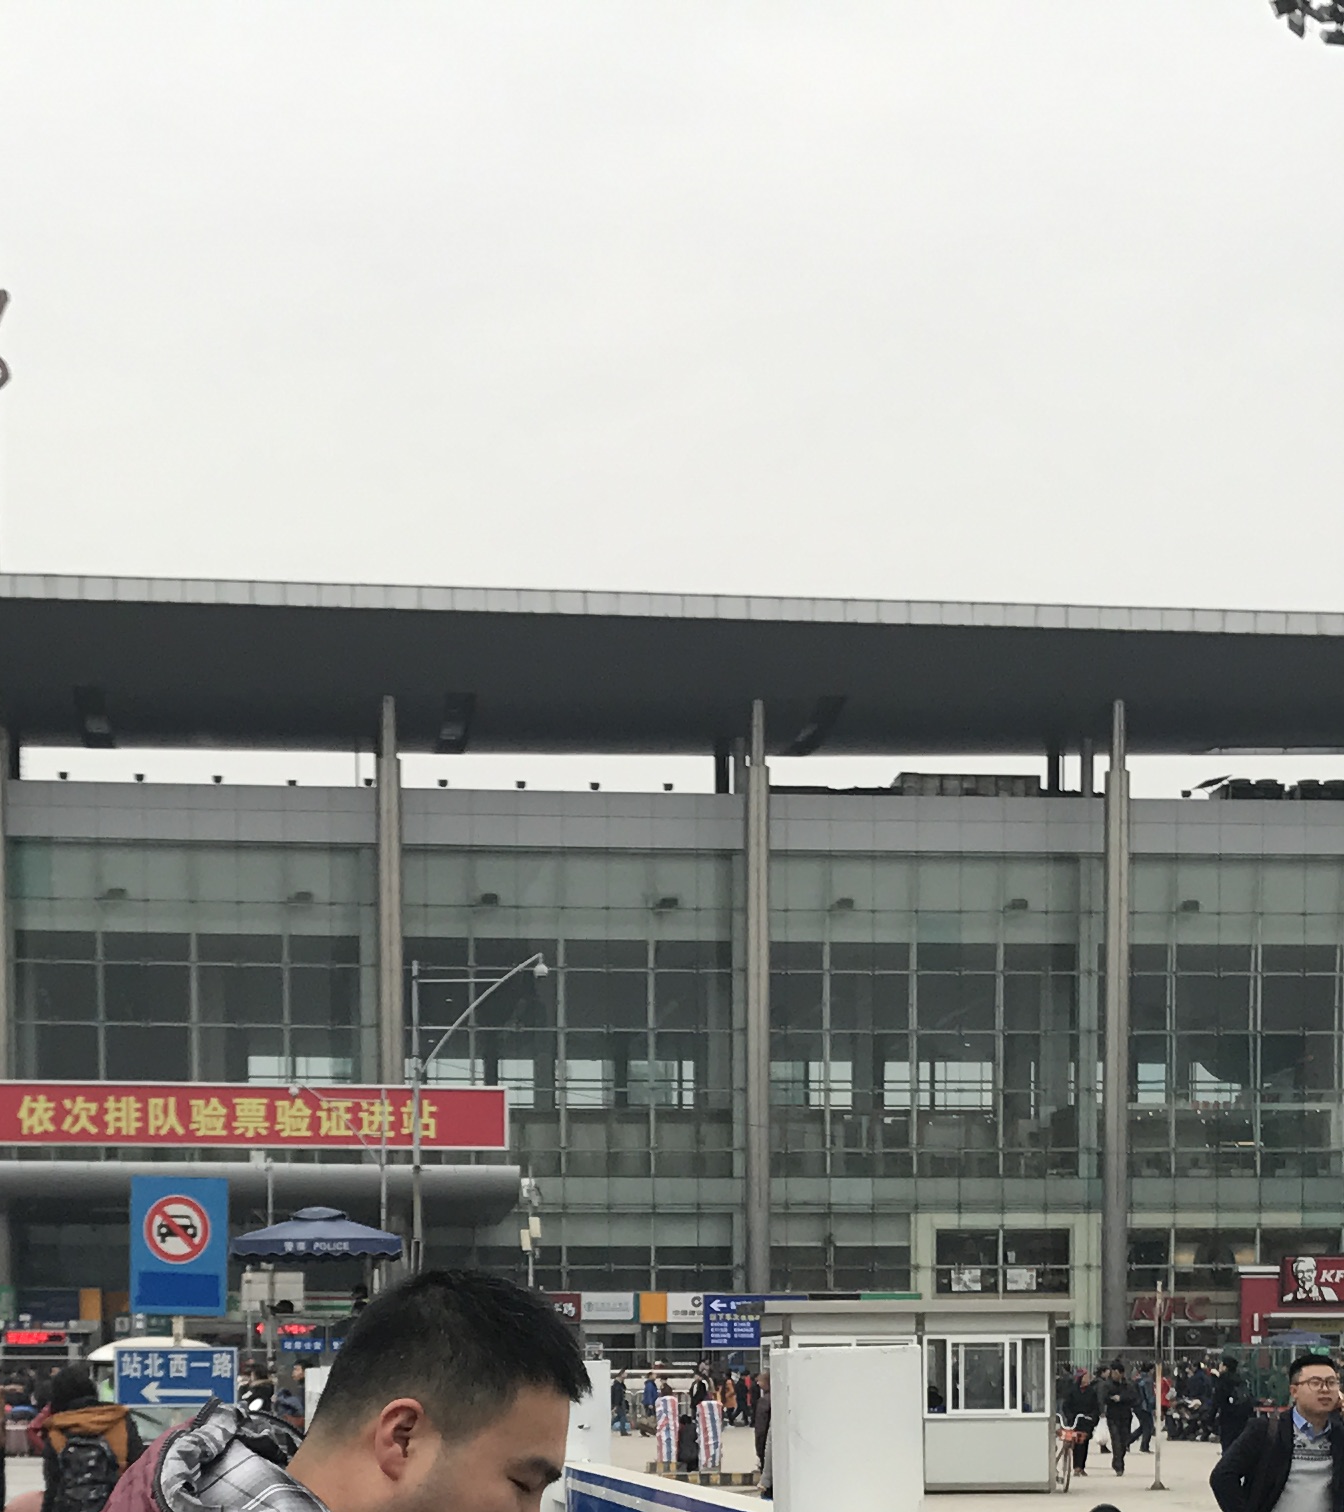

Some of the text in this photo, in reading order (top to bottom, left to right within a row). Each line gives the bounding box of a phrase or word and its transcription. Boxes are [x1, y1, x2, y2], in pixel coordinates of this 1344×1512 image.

[18, 1095, 439, 1140] 依次排队验票验证进站
[313, 1241, 350, 1251] POLICE
[120, 1352, 233, 1379] 站北西一路
